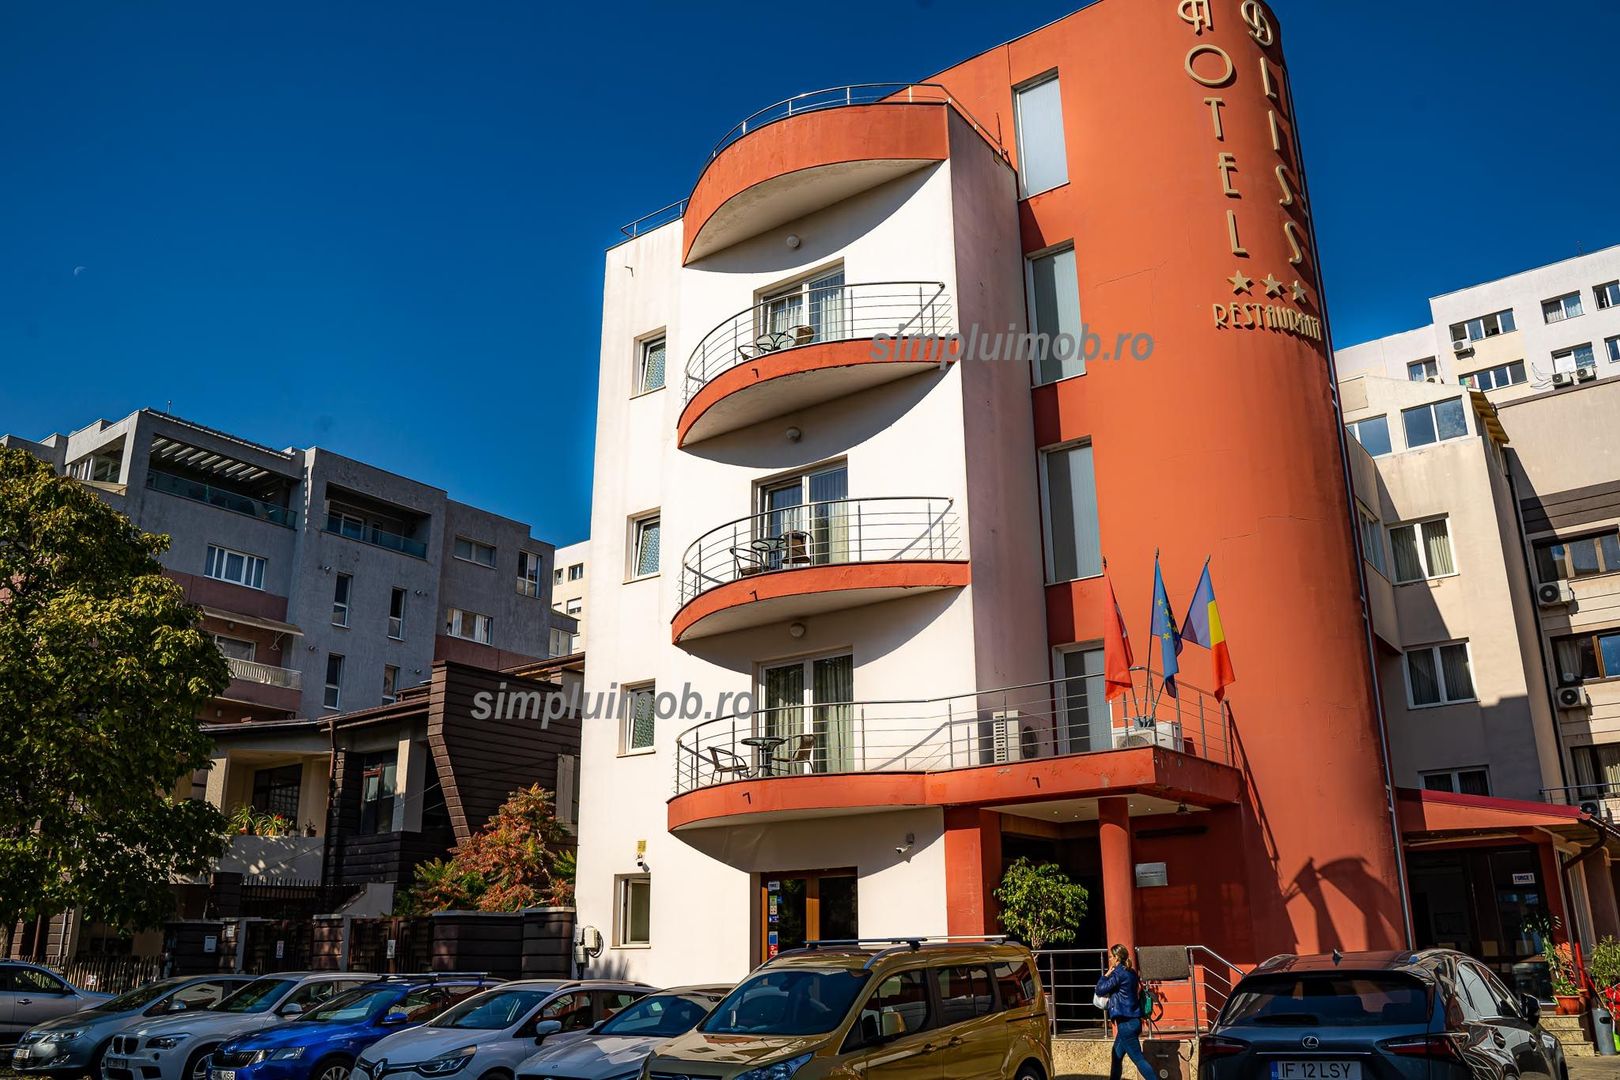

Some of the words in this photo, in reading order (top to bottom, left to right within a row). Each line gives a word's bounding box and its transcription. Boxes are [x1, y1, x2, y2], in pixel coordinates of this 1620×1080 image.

[1282, 1063, 1296, 1078] IF
[1301, 1063, 1316, 1078] 12
[1320, 1063, 1351, 1079] LSY
